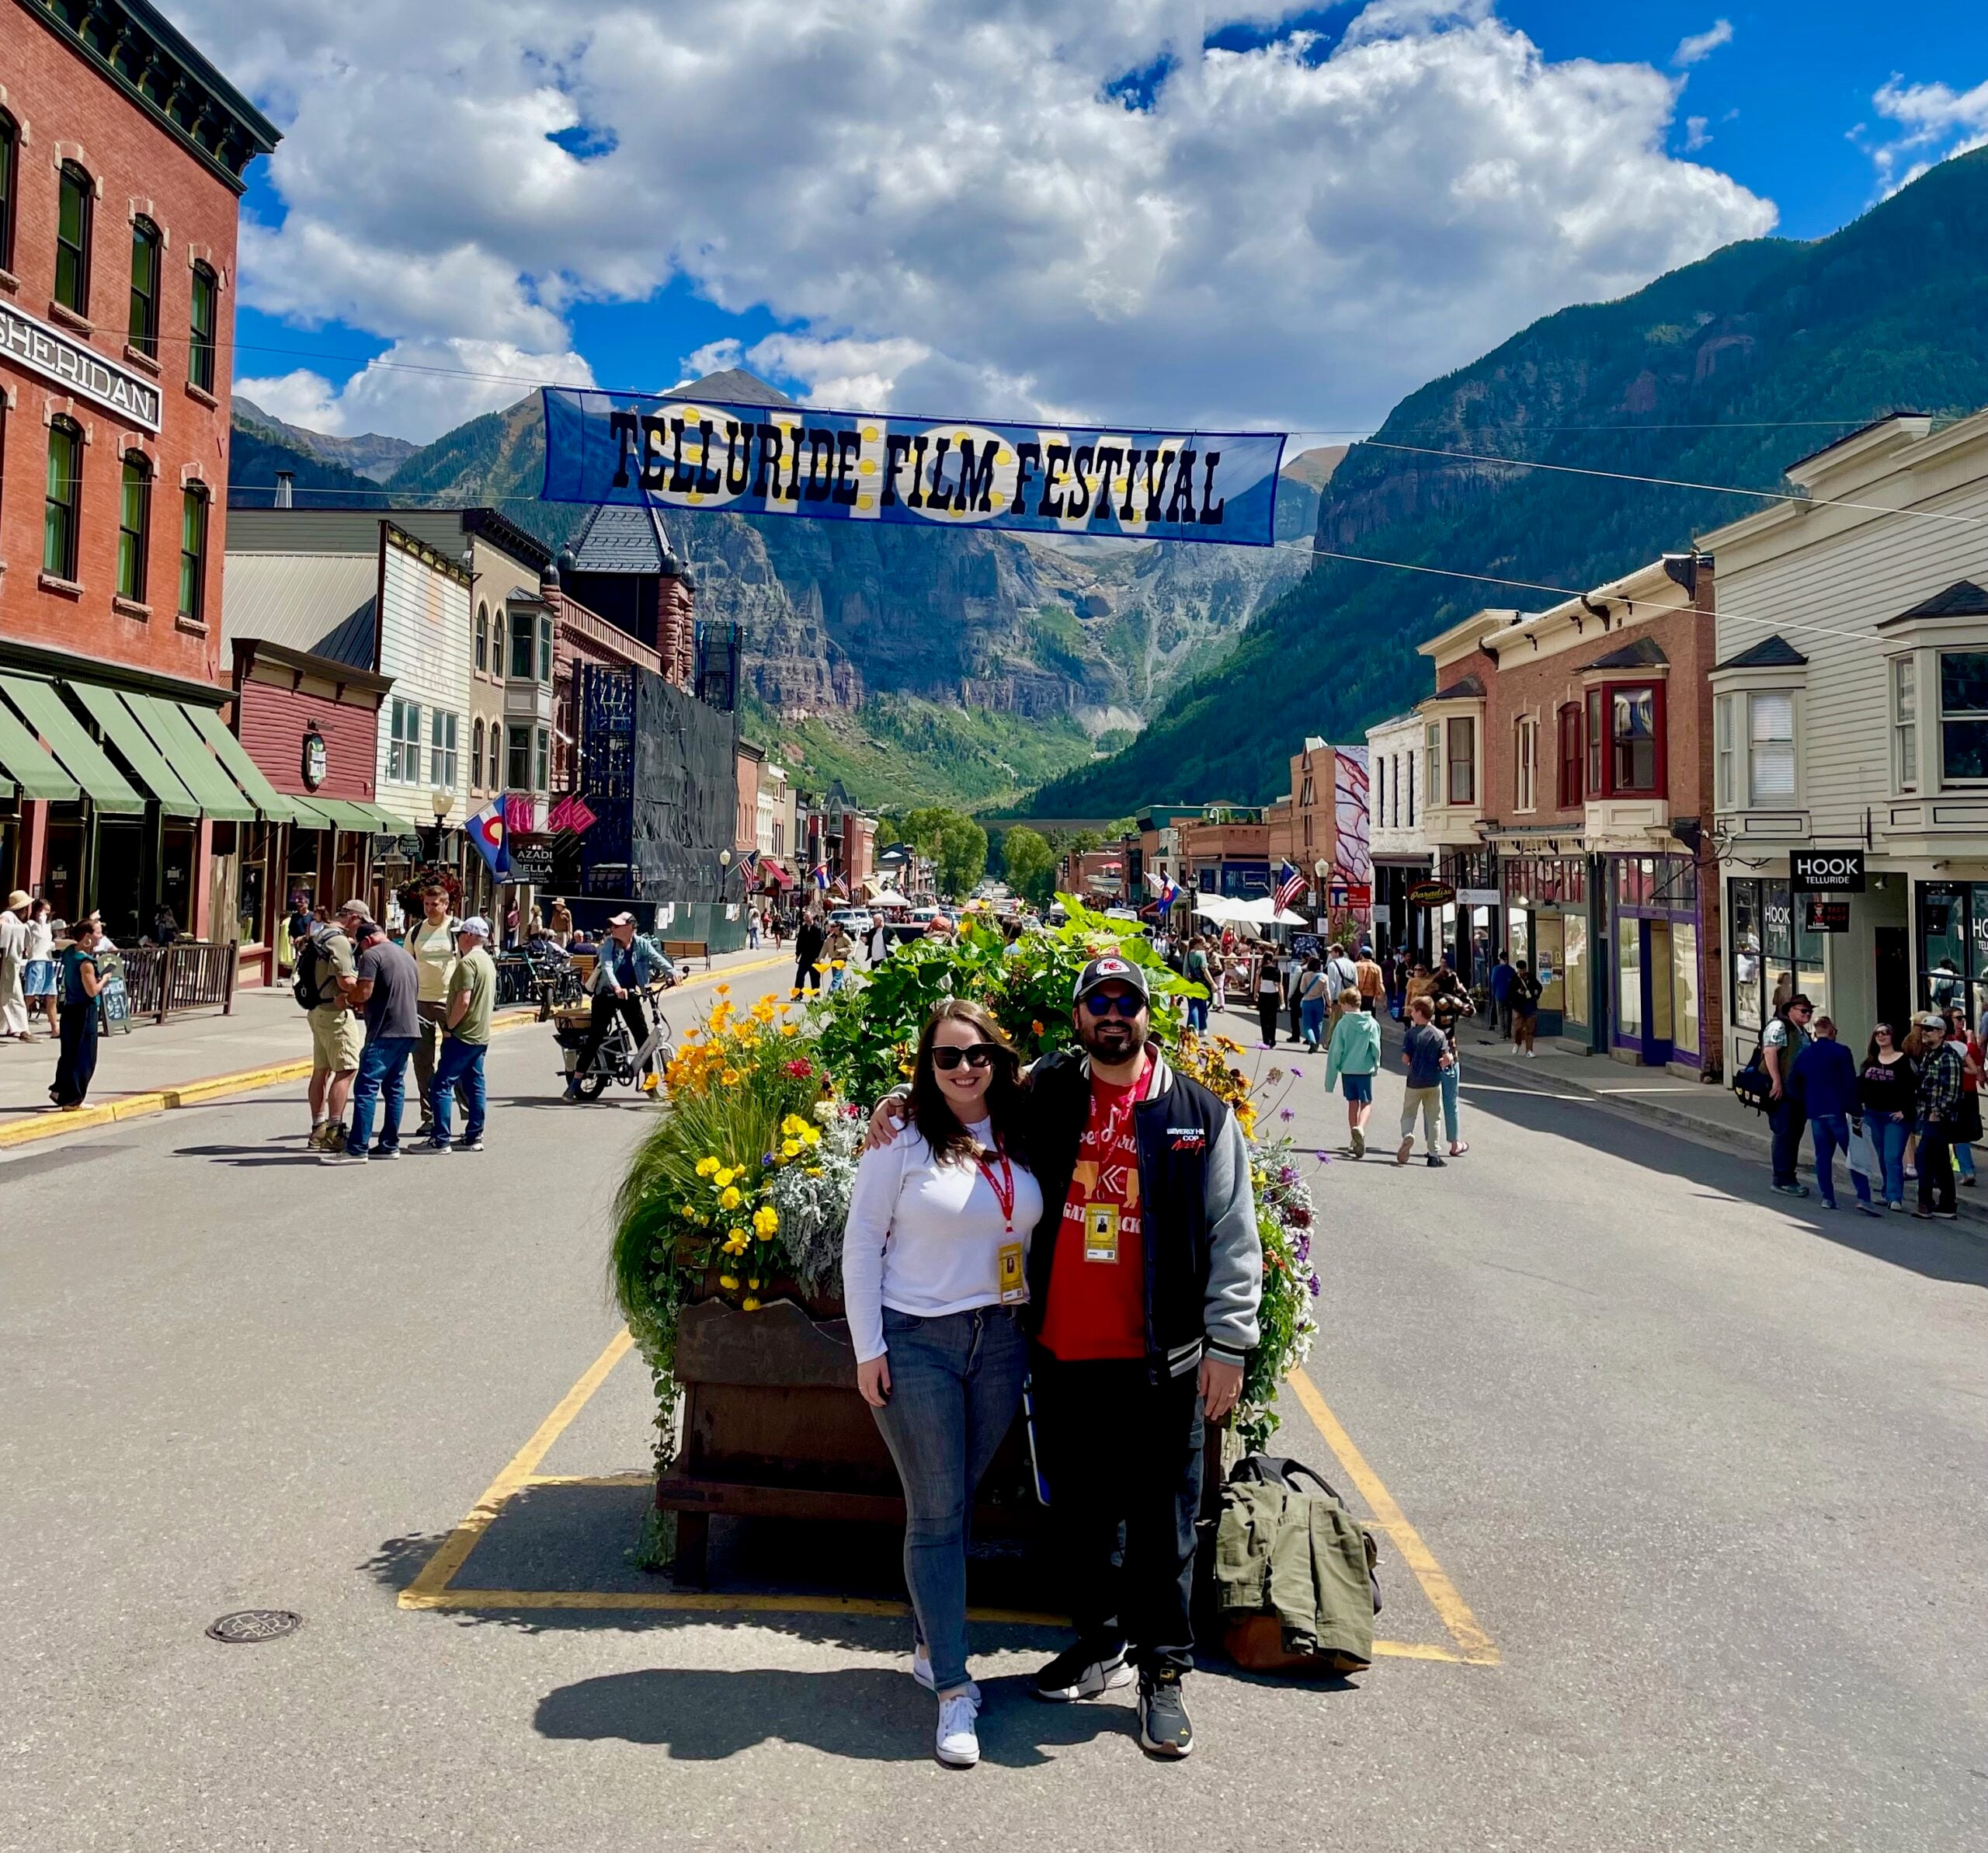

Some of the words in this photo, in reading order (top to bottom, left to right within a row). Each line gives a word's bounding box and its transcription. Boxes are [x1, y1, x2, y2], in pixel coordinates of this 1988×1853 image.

[610, 412, 862, 506] TELLURIDE
[880, 434, 1000, 513] FILM
[1011, 442, 1225, 525] FESTIVAL
[517, 850, 553, 859] AZADI
[519, 864, 553, 873] ELLA
[1798, 858, 1858, 874] HOOK
[1410, 888, 1453, 901] Paradise
[1764, 906, 1791, 924] HOOK
[1062, 1202, 1086, 1223] GAT
